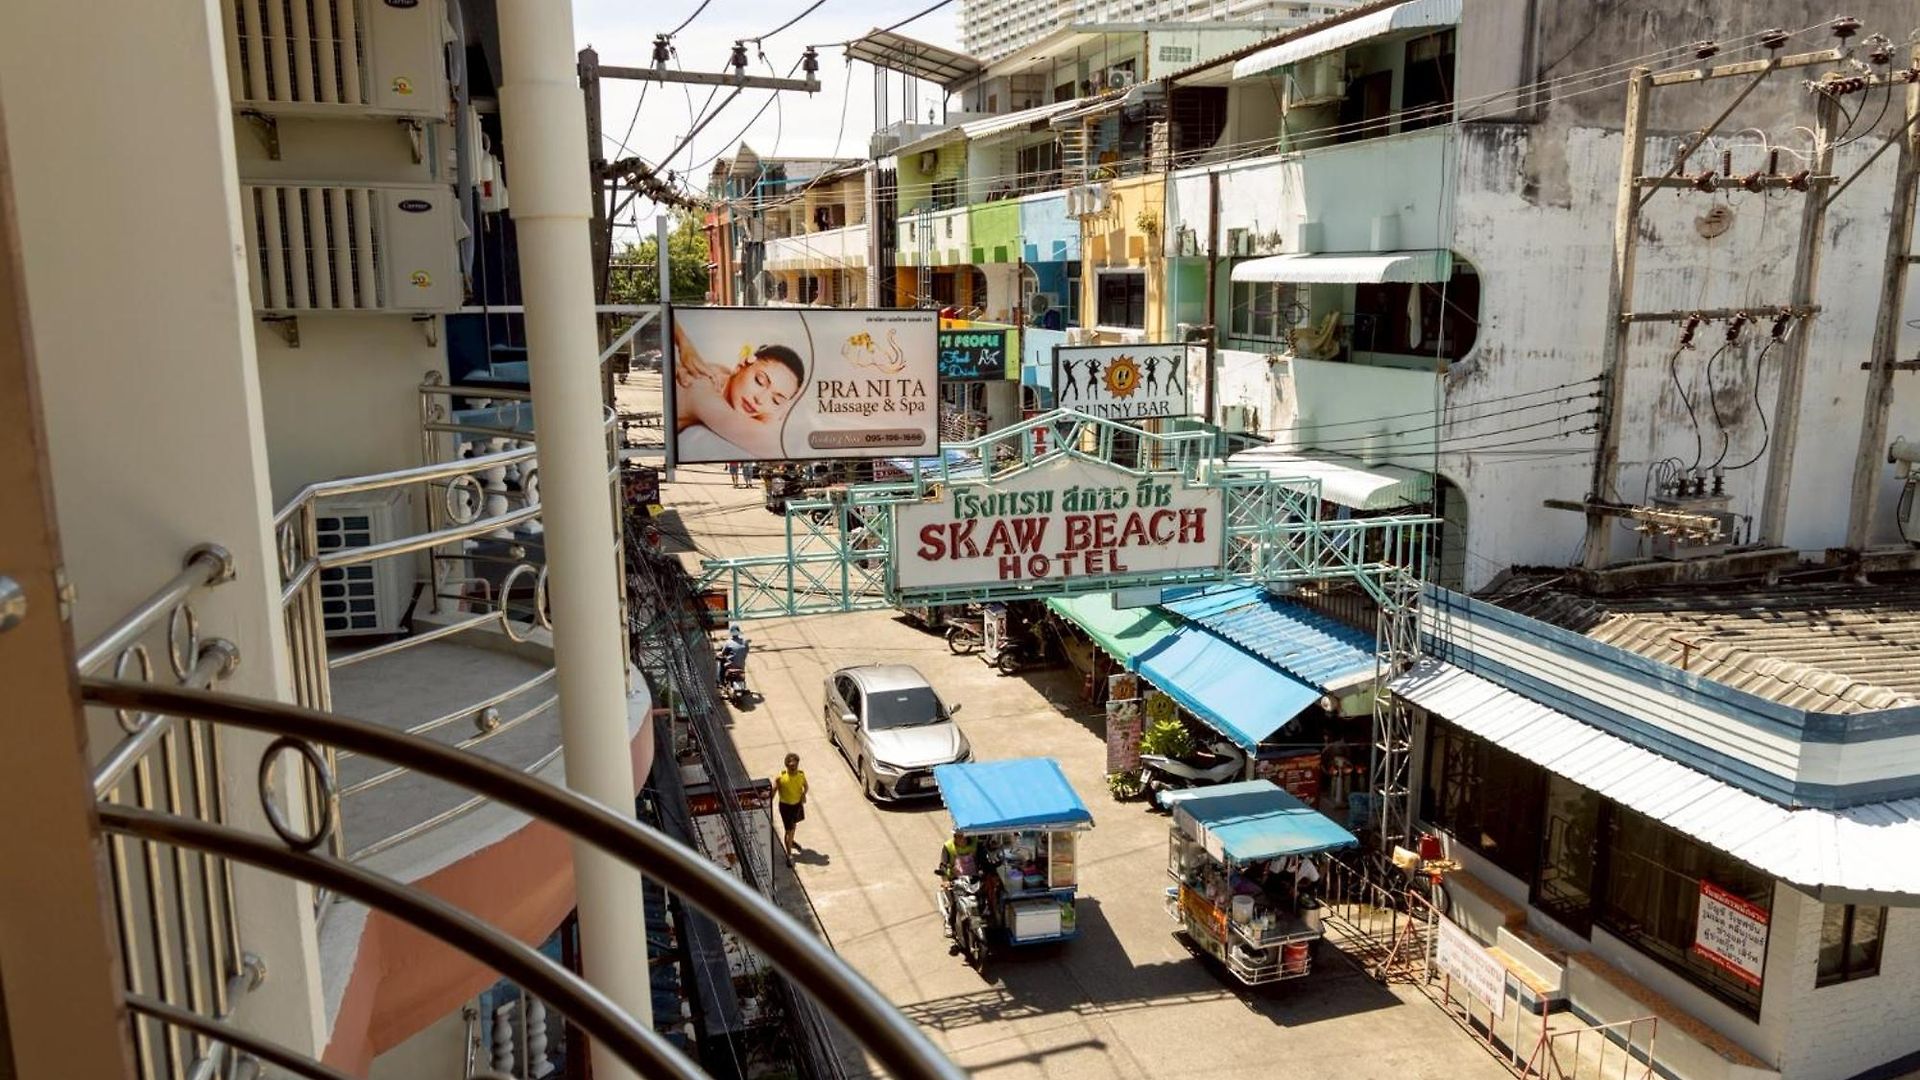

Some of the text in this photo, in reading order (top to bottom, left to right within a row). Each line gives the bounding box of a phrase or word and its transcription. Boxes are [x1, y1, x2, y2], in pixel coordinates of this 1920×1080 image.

[954, 334, 999, 348] PEOPLE
[817, 379, 926, 398] PRA NI TA
[818, 398, 925, 416] Massage & Spa
[1074, 402, 1132, 419] SUNNY
[1137, 401, 1170, 416] BAR
[953, 487, 1054, 519] โรงแรม
[1136, 478, 1172, 508] บีช
[917, 508, 1207, 561] SKAW BEACH
[999, 549, 1127, 579] HOTEL
